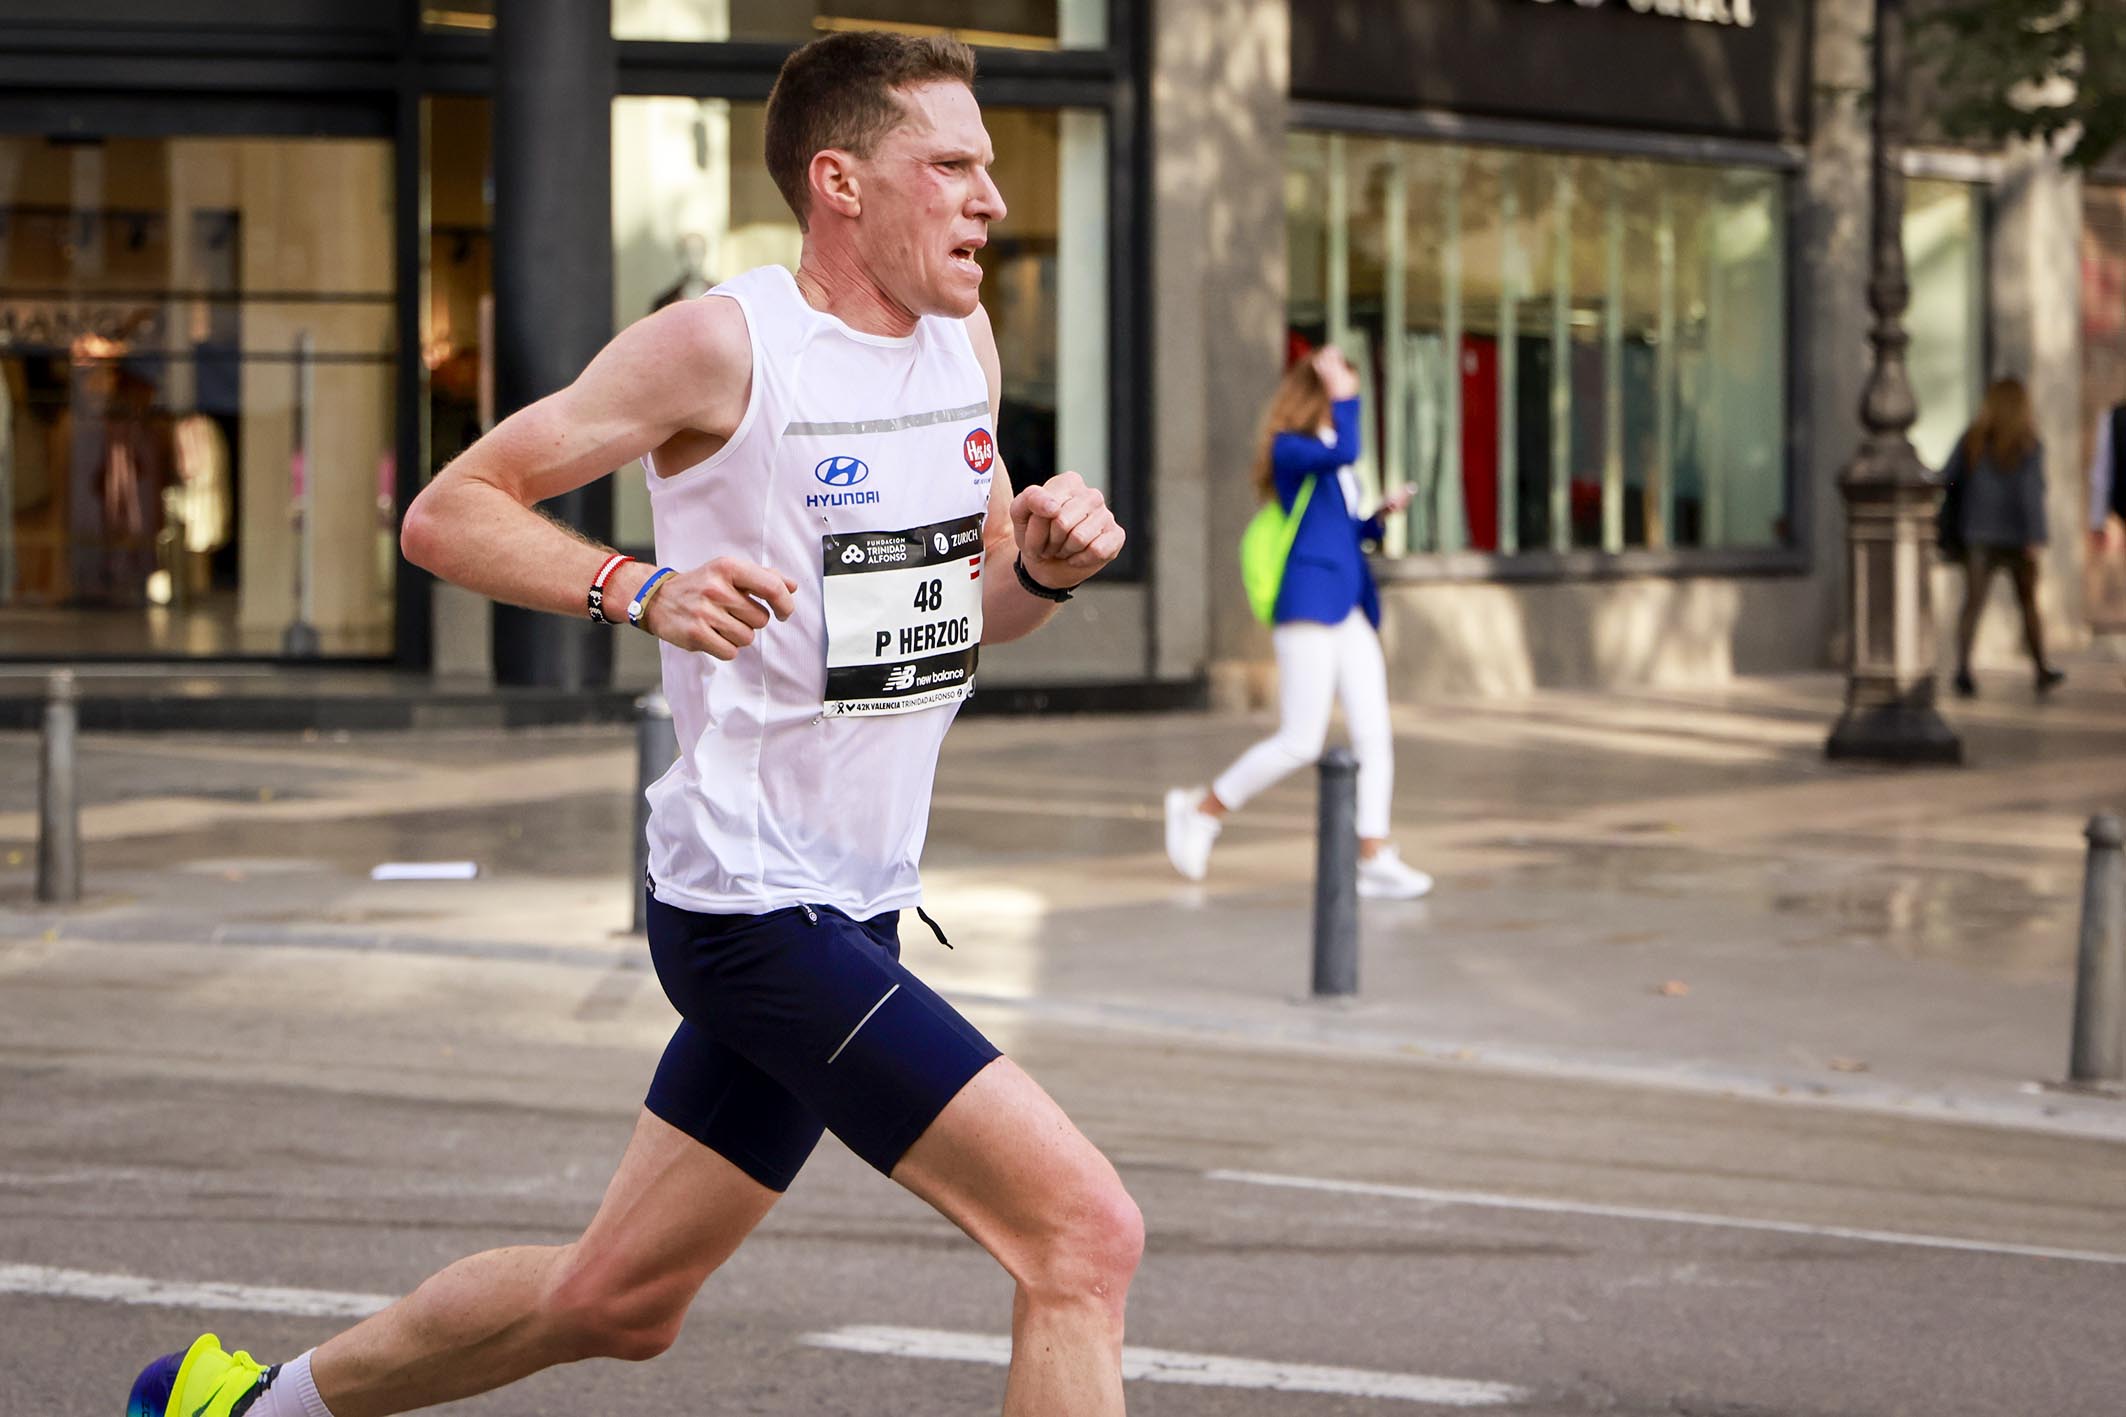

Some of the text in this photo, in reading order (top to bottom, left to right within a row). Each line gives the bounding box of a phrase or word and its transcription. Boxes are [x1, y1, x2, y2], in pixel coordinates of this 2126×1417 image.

[806, 491, 880, 507] HYUNDAI
[951, 528, 978, 547] ZURICH
[867, 544, 906, 556] TRINIDAD
[867, 552, 907, 564] ALFONSO
[913, 578, 943, 612] 48
[875, 616, 969, 657] P HERZOG
[916, 675, 932, 687] new
[932, 668, 964, 686] balance
[856, 691, 956, 712] 42K VALENCIA TRINIDAD ALFONSO
